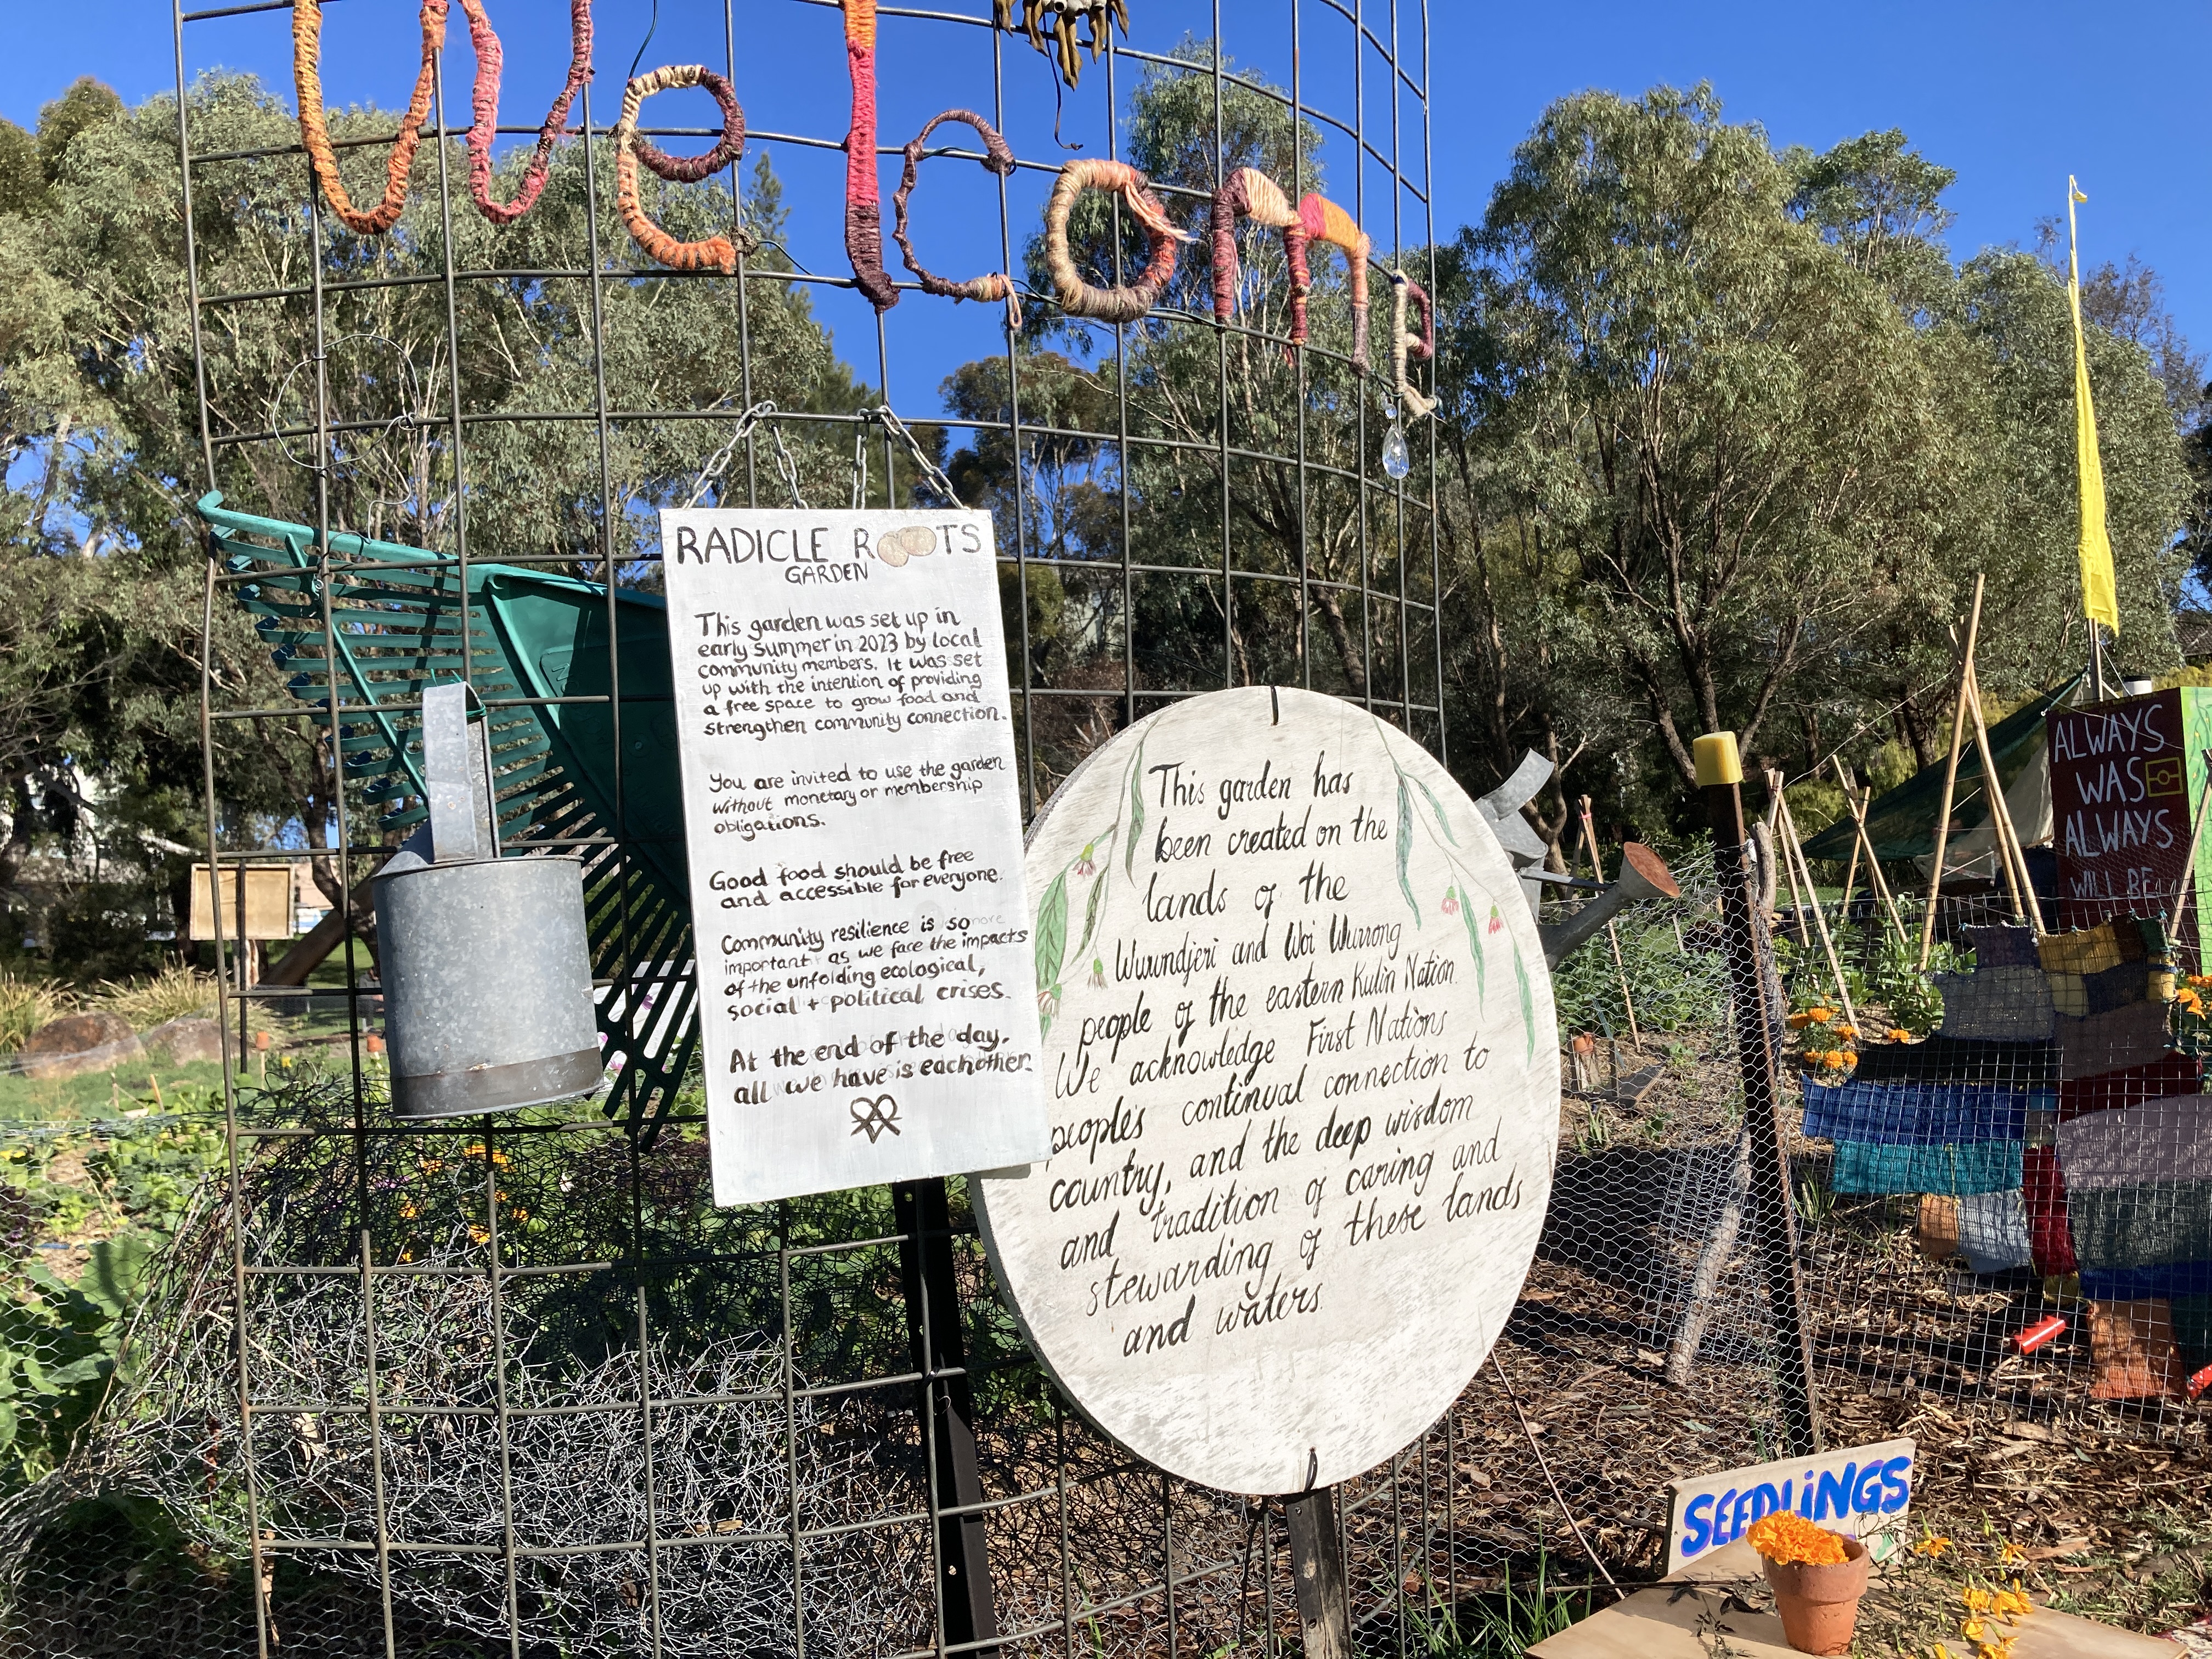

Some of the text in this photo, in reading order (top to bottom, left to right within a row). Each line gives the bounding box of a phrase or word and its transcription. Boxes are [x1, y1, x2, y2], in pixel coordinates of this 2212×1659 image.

[676, 526, 828, 565] RADICLE
[785, 562, 869, 585] GARDEN
[695, 606, 961, 641] This garden was set up in
[697, 627, 983, 663] early summer in 2023 by local
[697, 651, 982, 679] community members. It was set
[702, 671, 982, 699] up with the intention of providing
[703, 689, 981, 716] a free space to grow food and
[703, 706, 1007, 741] strengthen community connection.
[2055, 703, 2164, 763] ALWAYS
[709, 754, 1007, 793] You are invited to use the garden
[713, 778, 983, 814] without monetary or membership
[1148, 749, 1354, 820] This garden has
[2075, 757, 2145, 805] WAS
[714, 813, 826, 841] obligations.
[1155, 804, 1387, 863] been created on the
[2066, 809, 2174, 857] ALWAYS
[709, 848, 975, 891] Good food should be free
[720, 890, 772, 909] and
[779, 880, 883, 902] accessible
[890, 876, 919, 898] for
[1142, 859, 1350, 922] lands of the
[2070, 867, 2154, 899] WILL BE
[721, 916, 970, 956] Community resilience is so
[725, 928, 1029, 977] important as we face the impacts
[1232, 919, 1269, 965] and
[1284, 920, 1316, 961] Woi
[724, 954, 986, 1000] of the unfolding ecological,
[728, 979, 1011, 1021] social + political crises.
[1076, 990, 1152, 1069] people
[1175, 1000, 1196, 1048] of
[1209, 973, 1248, 1027] the
[1266, 961, 1344, 1013] eastern
[1352, 956, 1395, 1001] Kulin
[730, 1048, 758, 1073] At
[770, 1045, 809, 1066] the
[814, 1034, 860, 1061] end
[870, 1030, 897, 1056] of
[908, 1025, 945, 1048] the
[1056, 998, 1448, 1099] We acknowledge First Nations
[734, 1080, 772, 1105] all
[785, 1078, 823, 1094] we
[832, 1068, 887, 1088] have
[895, 1059, 914, 1080] is
[1182, 1063, 1308, 1126] continual
[1324, 1045, 1449, 1098] connection
[1464, 1031, 1491, 1071] to
[1049, 1084, 1473, 1215] country, and the deep wisdom
[1061, 1116, 1502, 1270] and tradition of caring and
[1086, 1163, 1523, 1317] stewarding of these lands
[1123, 1294, 1196, 1357] and
